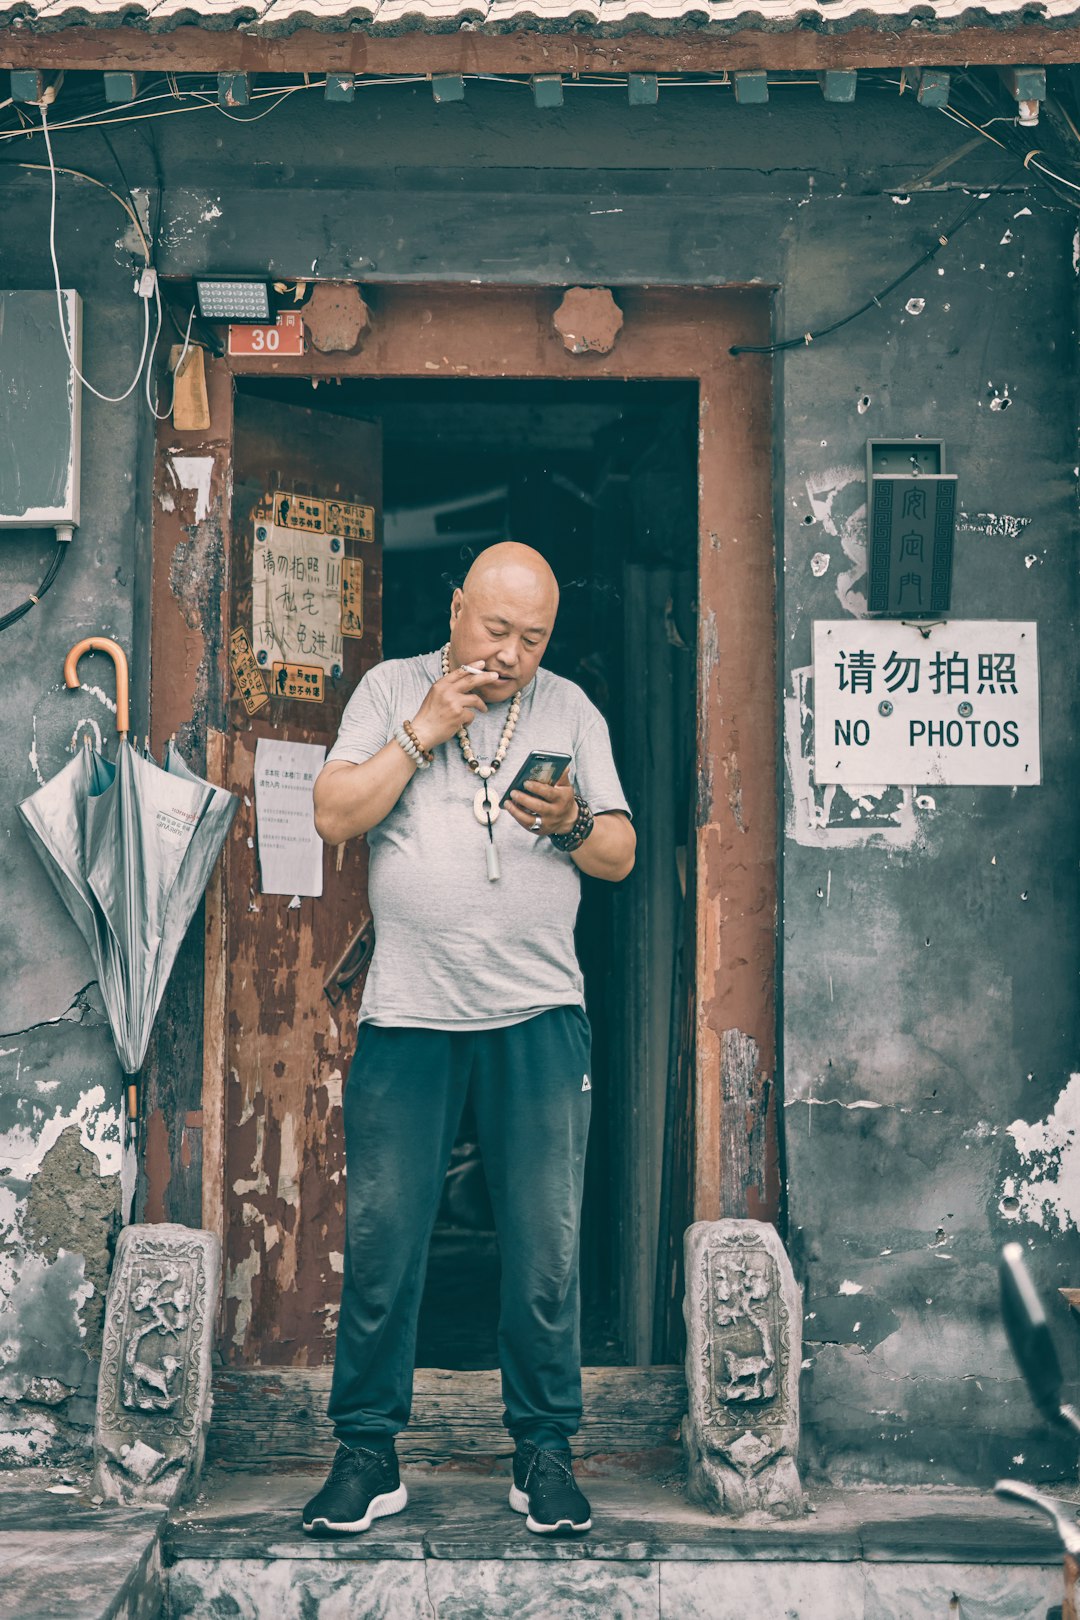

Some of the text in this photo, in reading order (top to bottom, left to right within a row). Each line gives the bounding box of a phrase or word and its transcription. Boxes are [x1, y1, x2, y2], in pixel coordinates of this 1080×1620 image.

[251, 329, 280, 351] 30
[275, 584, 320, 616] 私宅
[834, 649, 1019, 695] 请勿拍照
[834, 719, 1020, 747] NO PHOTOS
